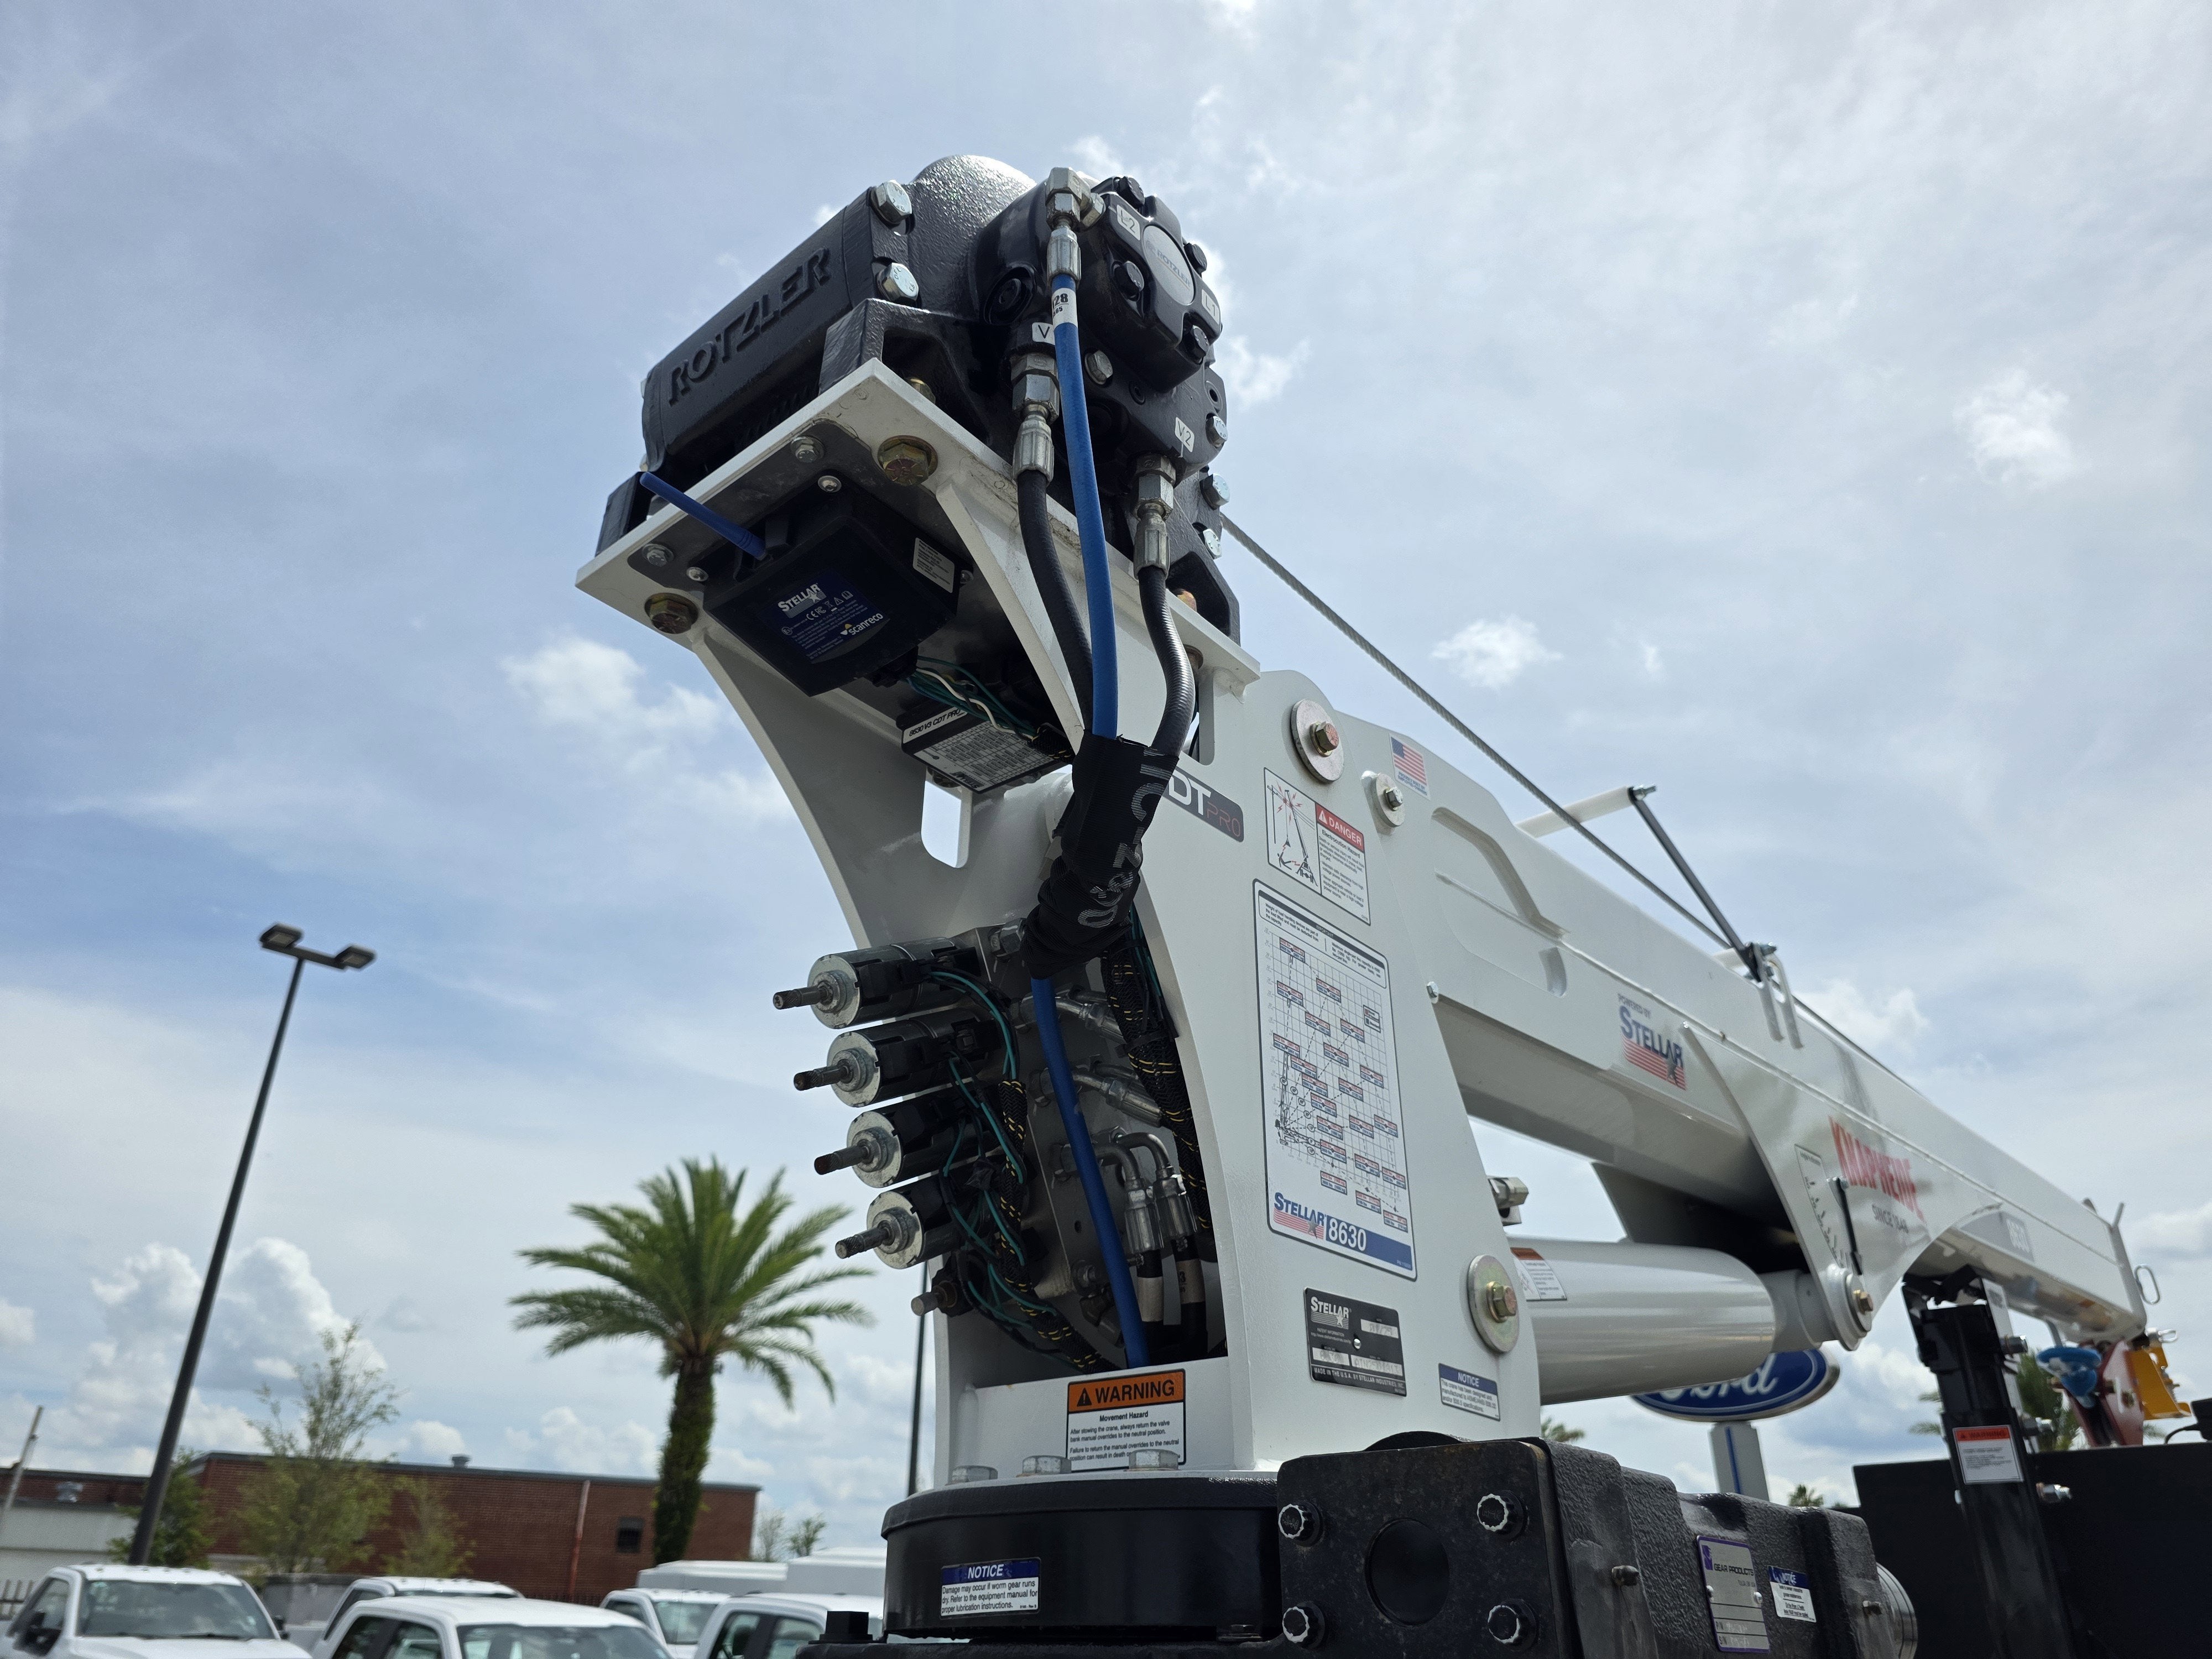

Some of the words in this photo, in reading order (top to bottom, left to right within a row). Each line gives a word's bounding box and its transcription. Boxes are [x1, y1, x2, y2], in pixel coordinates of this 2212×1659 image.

[1157, 250, 1191, 288] ROTZLER
[669, 247, 830, 408] ROTZLER
[1177, 420, 1192, 446] V2
[778, 583, 821, 612] STELLAR
[848, 613, 883, 636] scanreco
[1168, 774, 1211, 816] DT
[1207, 801, 1241, 837] PRO
[1328, 816, 1361, 847] DANGER
[1619, 1005, 1684, 1068] STELLAR
[1274, 1192, 1324, 1227] STELLAR
[1328, 1218, 1367, 1251] 8630
[1310, 1295, 1349, 1319] STELLAR
[1358, 1374, 1375, 1384] STELLAR
[1458, 1372, 1480, 1387] NOTICE
[1660, 1353, 1778, 1402] ord
[1095, 1379, 1174, 1404] WARNING
[968, 1564, 1004, 1579] NOTICE
[1714, 1563, 1729, 1573] GEAR
[1729, 1565, 1755, 1576] PRODUCTS
[978, 1592, 1005, 1601] equipment
[1007, 1590, 1027, 1598] manual
[1008, 1582, 1020, 1590] gear
[982, 1601, 1013, 1609] instructions.
